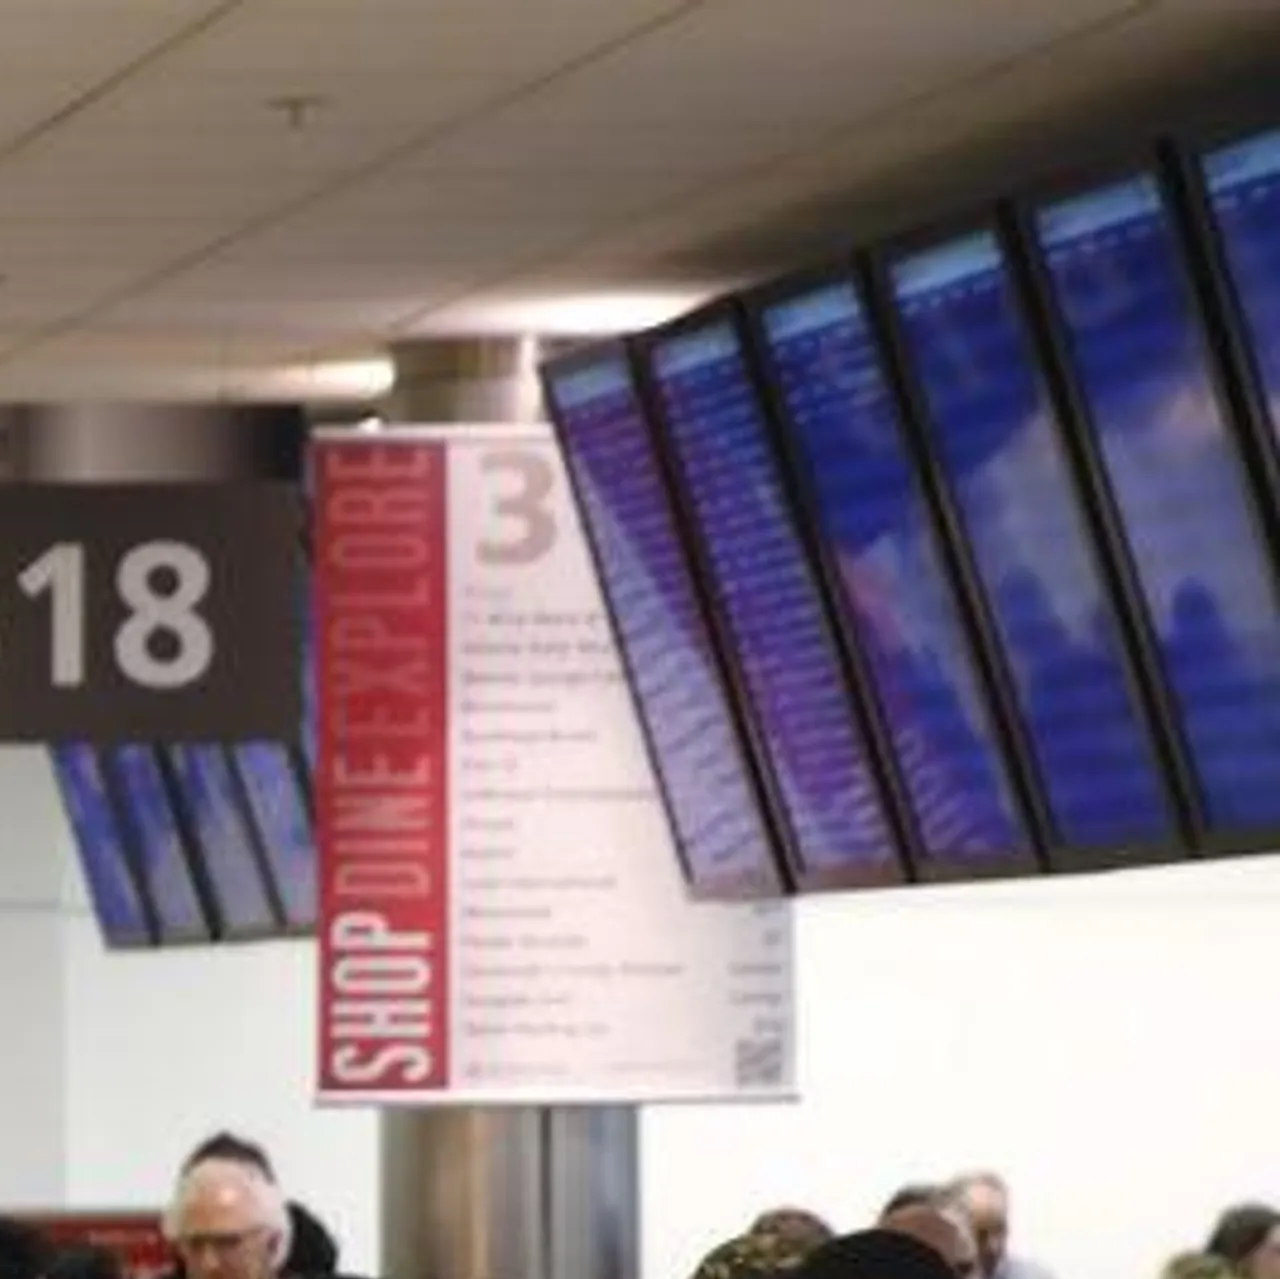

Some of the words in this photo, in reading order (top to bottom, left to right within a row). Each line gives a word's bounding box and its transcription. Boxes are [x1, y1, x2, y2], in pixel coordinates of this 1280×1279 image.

[476, 450, 557, 565] 3
[327, 447, 431, 740] EXPLORE
[331, 752, 431, 896] DINE
[331, 911, 431, 1083] SHOP
